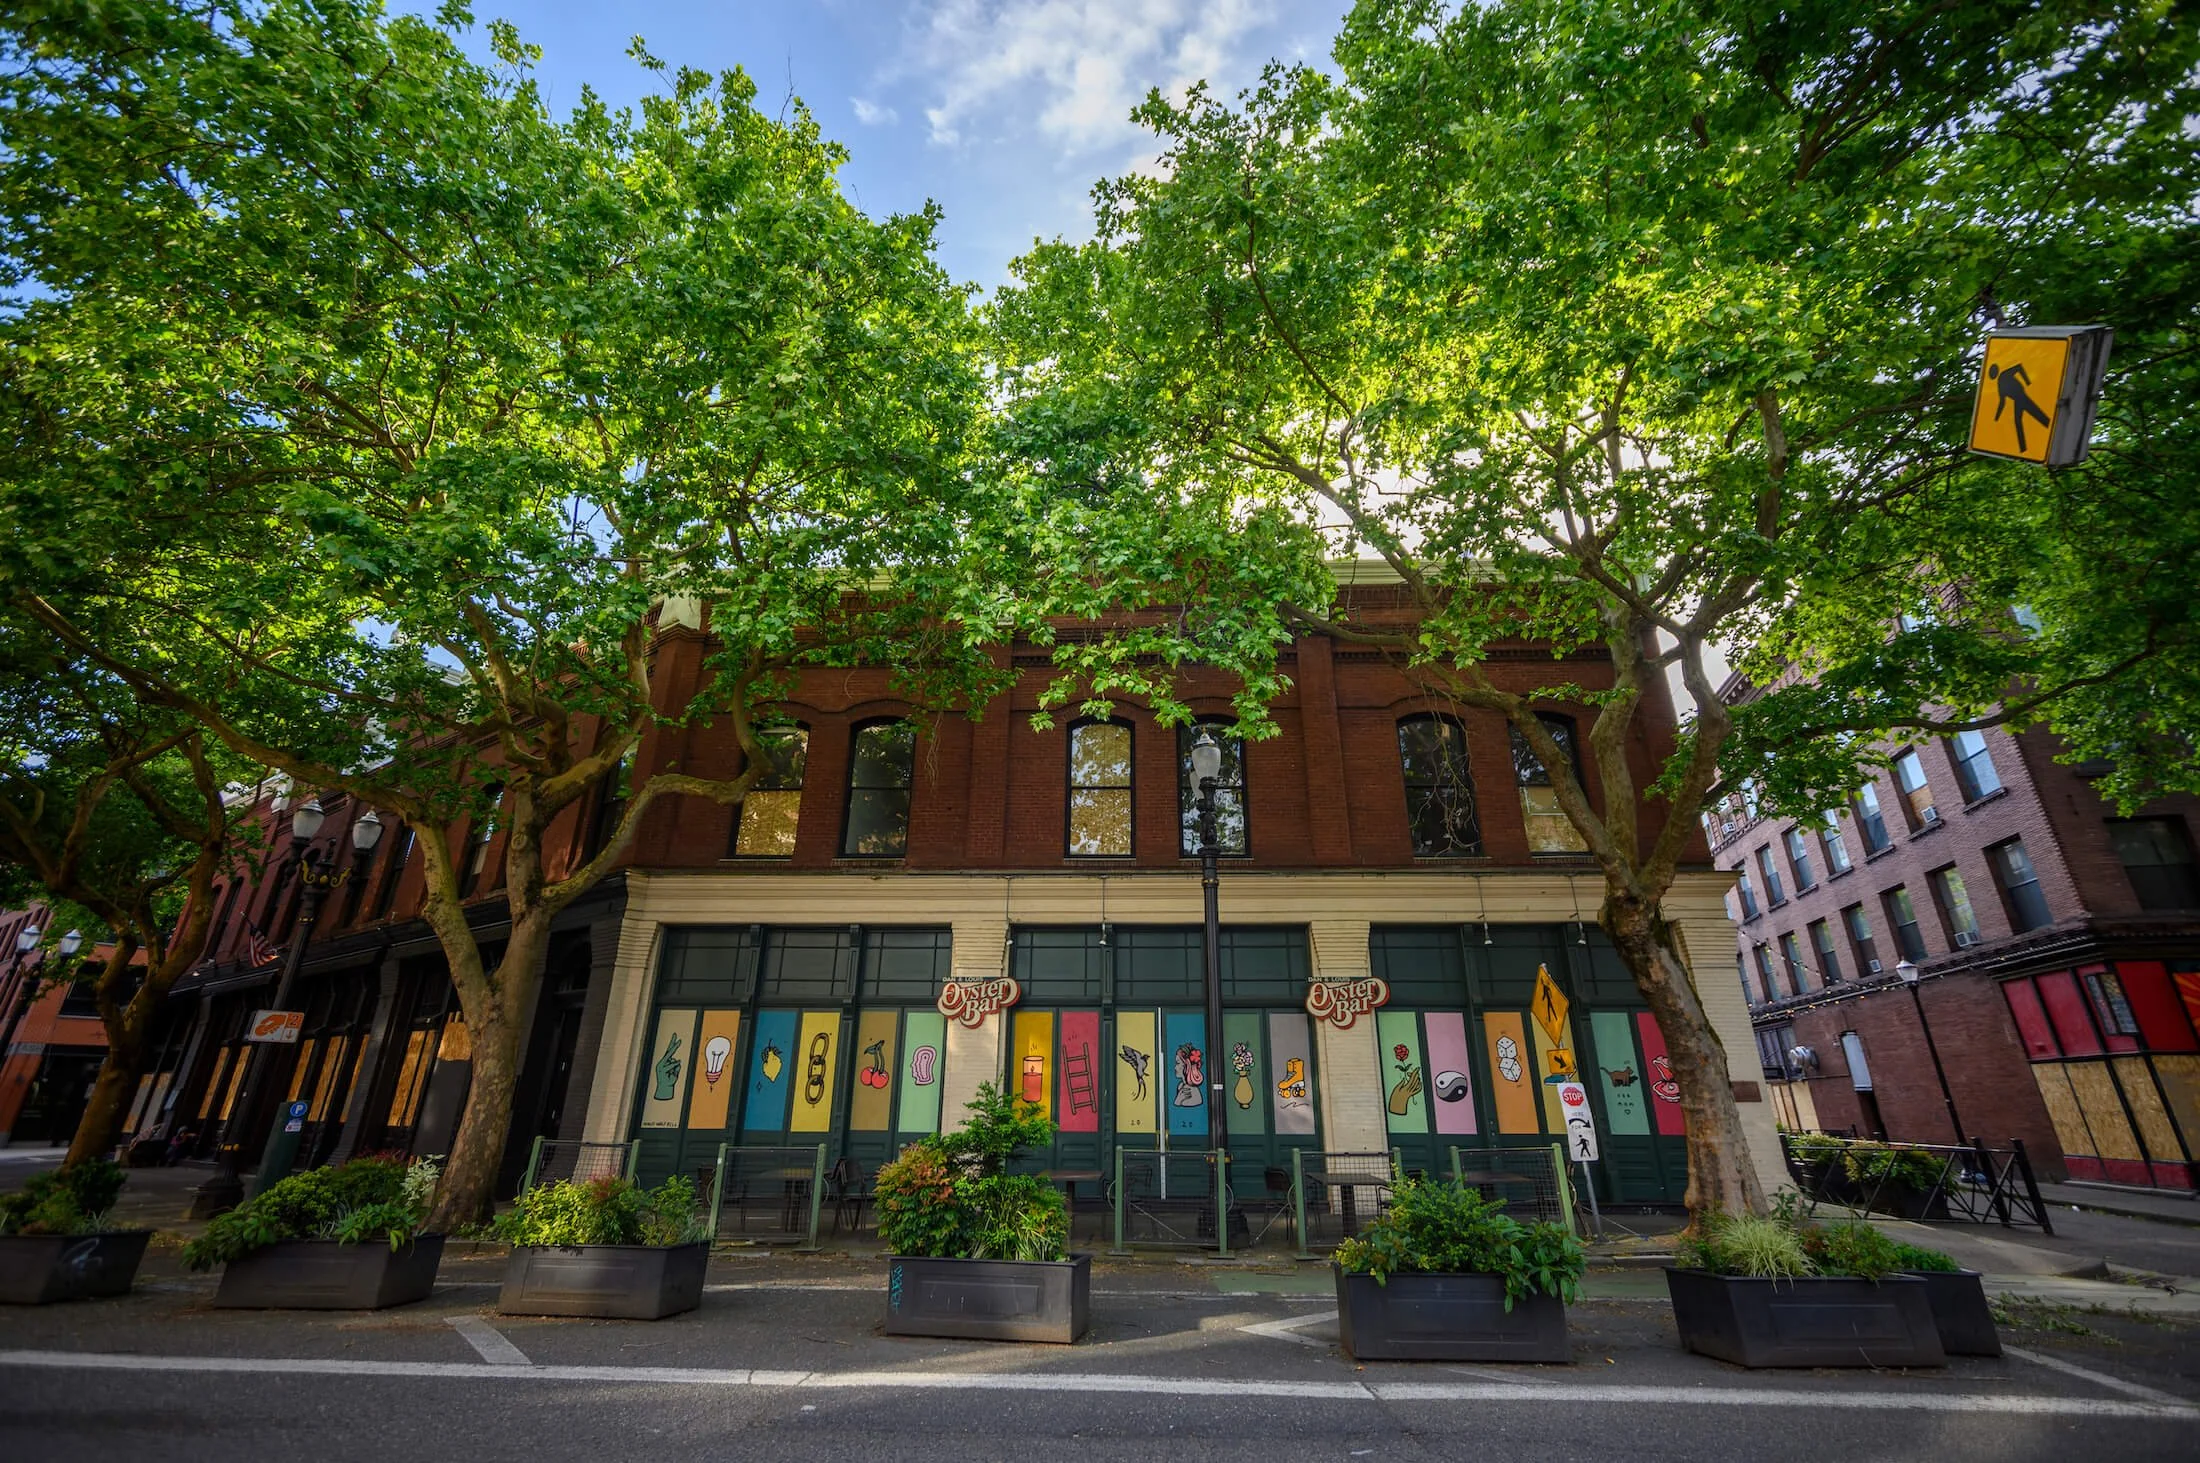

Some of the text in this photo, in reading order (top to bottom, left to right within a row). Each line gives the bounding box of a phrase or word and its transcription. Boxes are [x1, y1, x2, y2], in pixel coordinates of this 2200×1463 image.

[938, 978, 1018, 1016] Oyster
[959, 996, 1002, 1026] Bar
[1306, 978, 1387, 1017] Oyster
[1331, 996, 1373, 1026] Bar
[290, 1015, 299, 1026] 2
[295, 1104, 304, 1115] P
[1563, 1092, 1582, 1101] STOP
